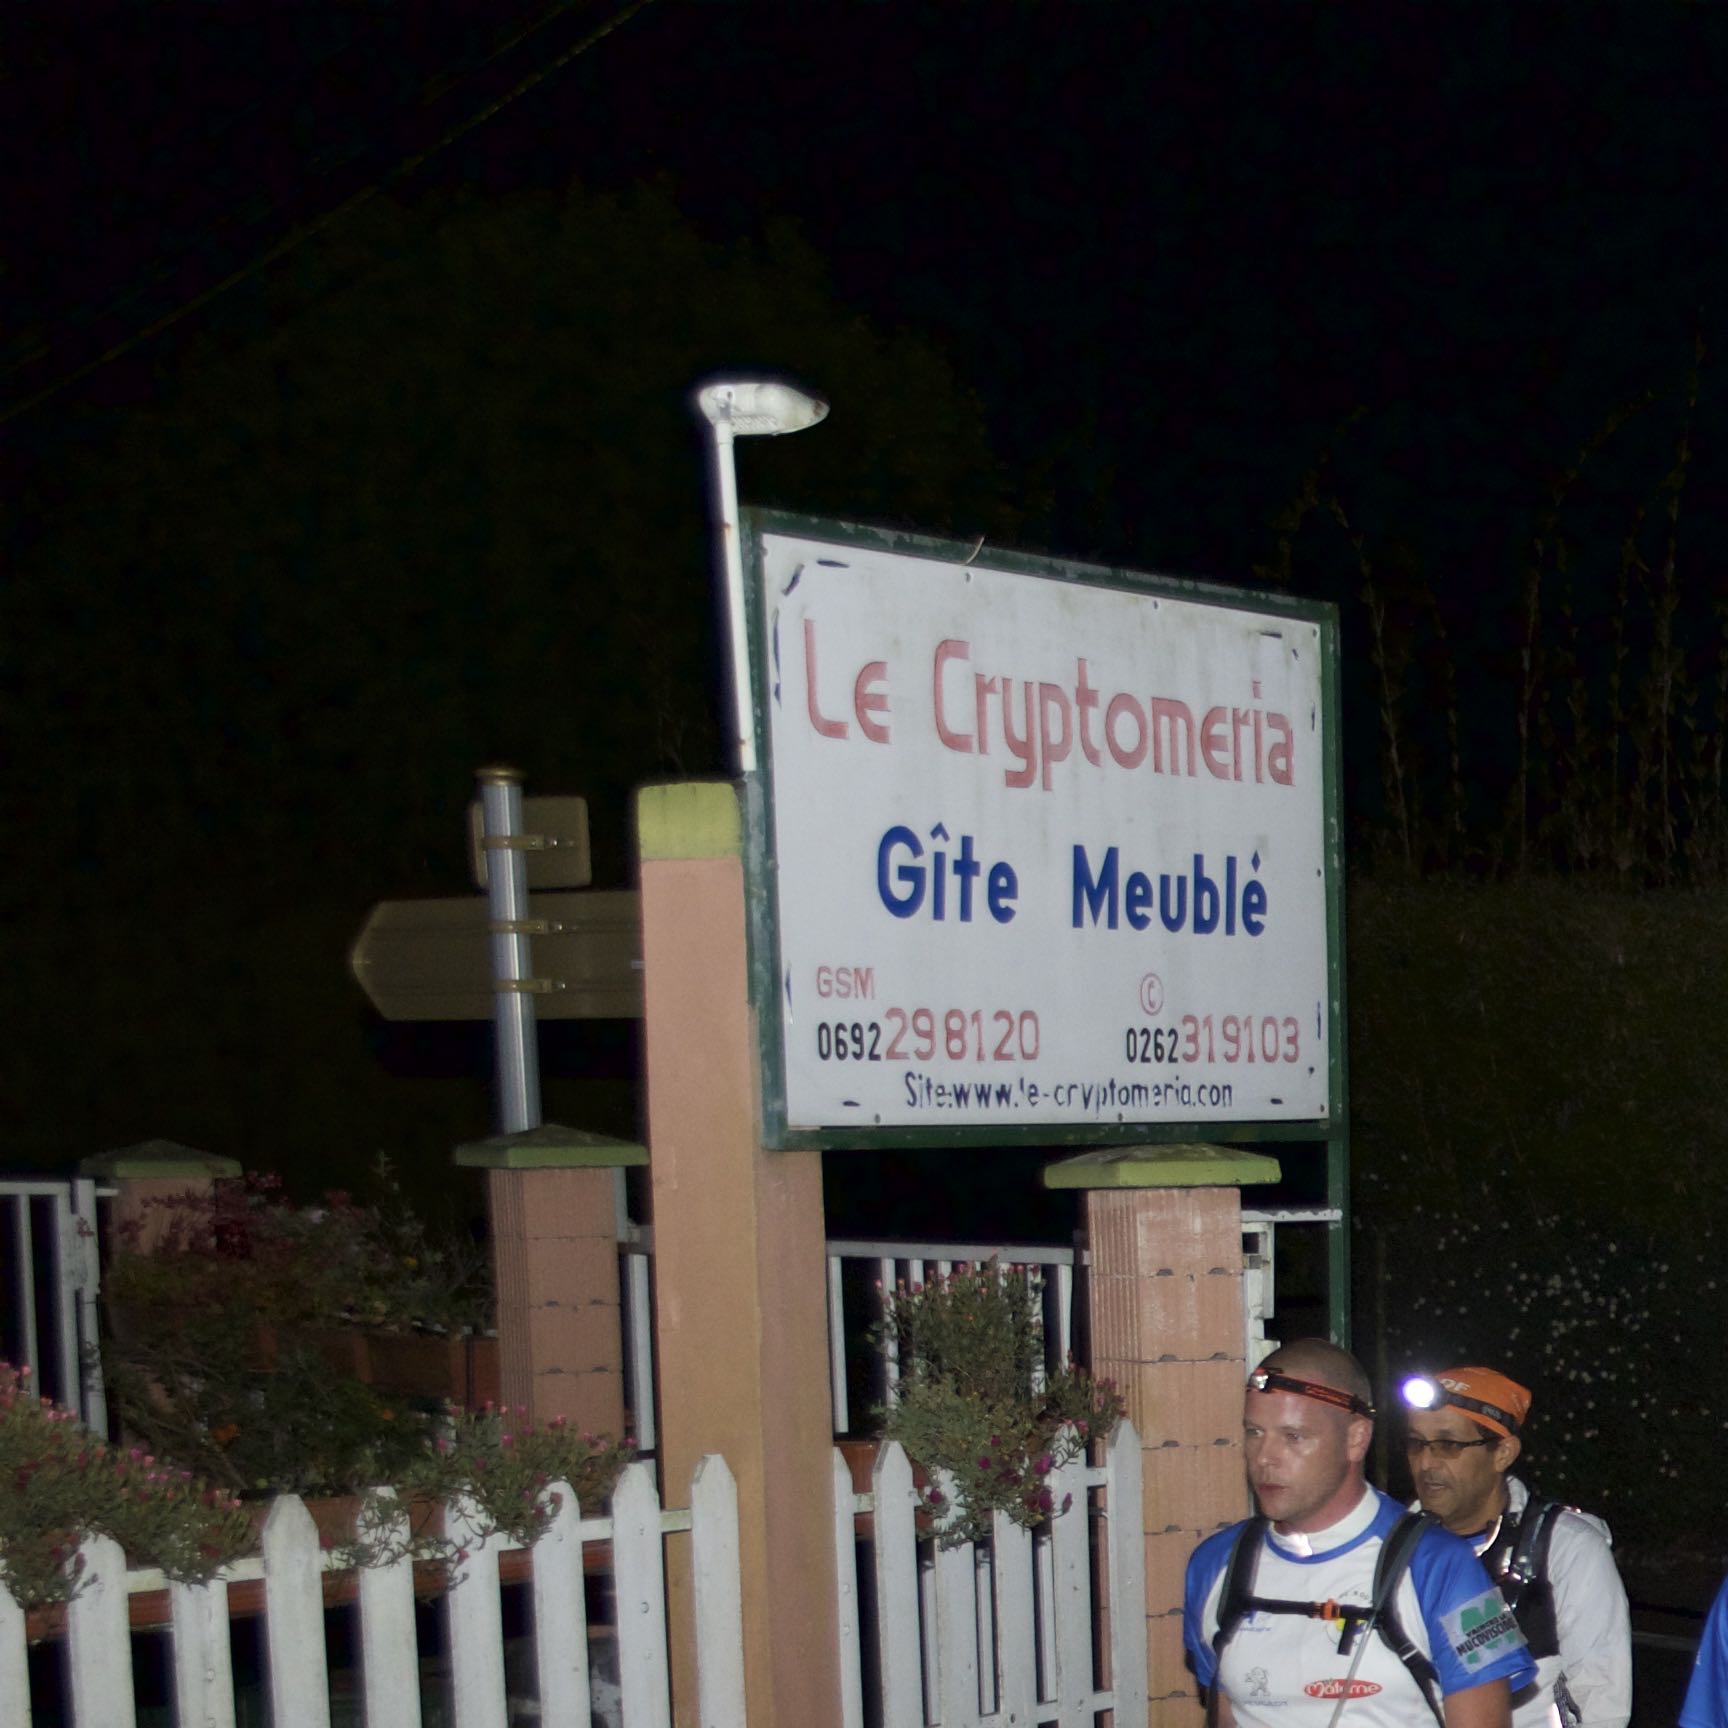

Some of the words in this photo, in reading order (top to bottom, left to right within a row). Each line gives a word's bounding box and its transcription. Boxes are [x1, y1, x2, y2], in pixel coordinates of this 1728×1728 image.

[804, 618, 892, 744] Le
[934, 638, 1296, 791] Cryptomeria
[877, 822, 1019, 923] Gîte
[1072, 845, 1268, 937] Meublé
[816, 965, 876, 1000] GSM
